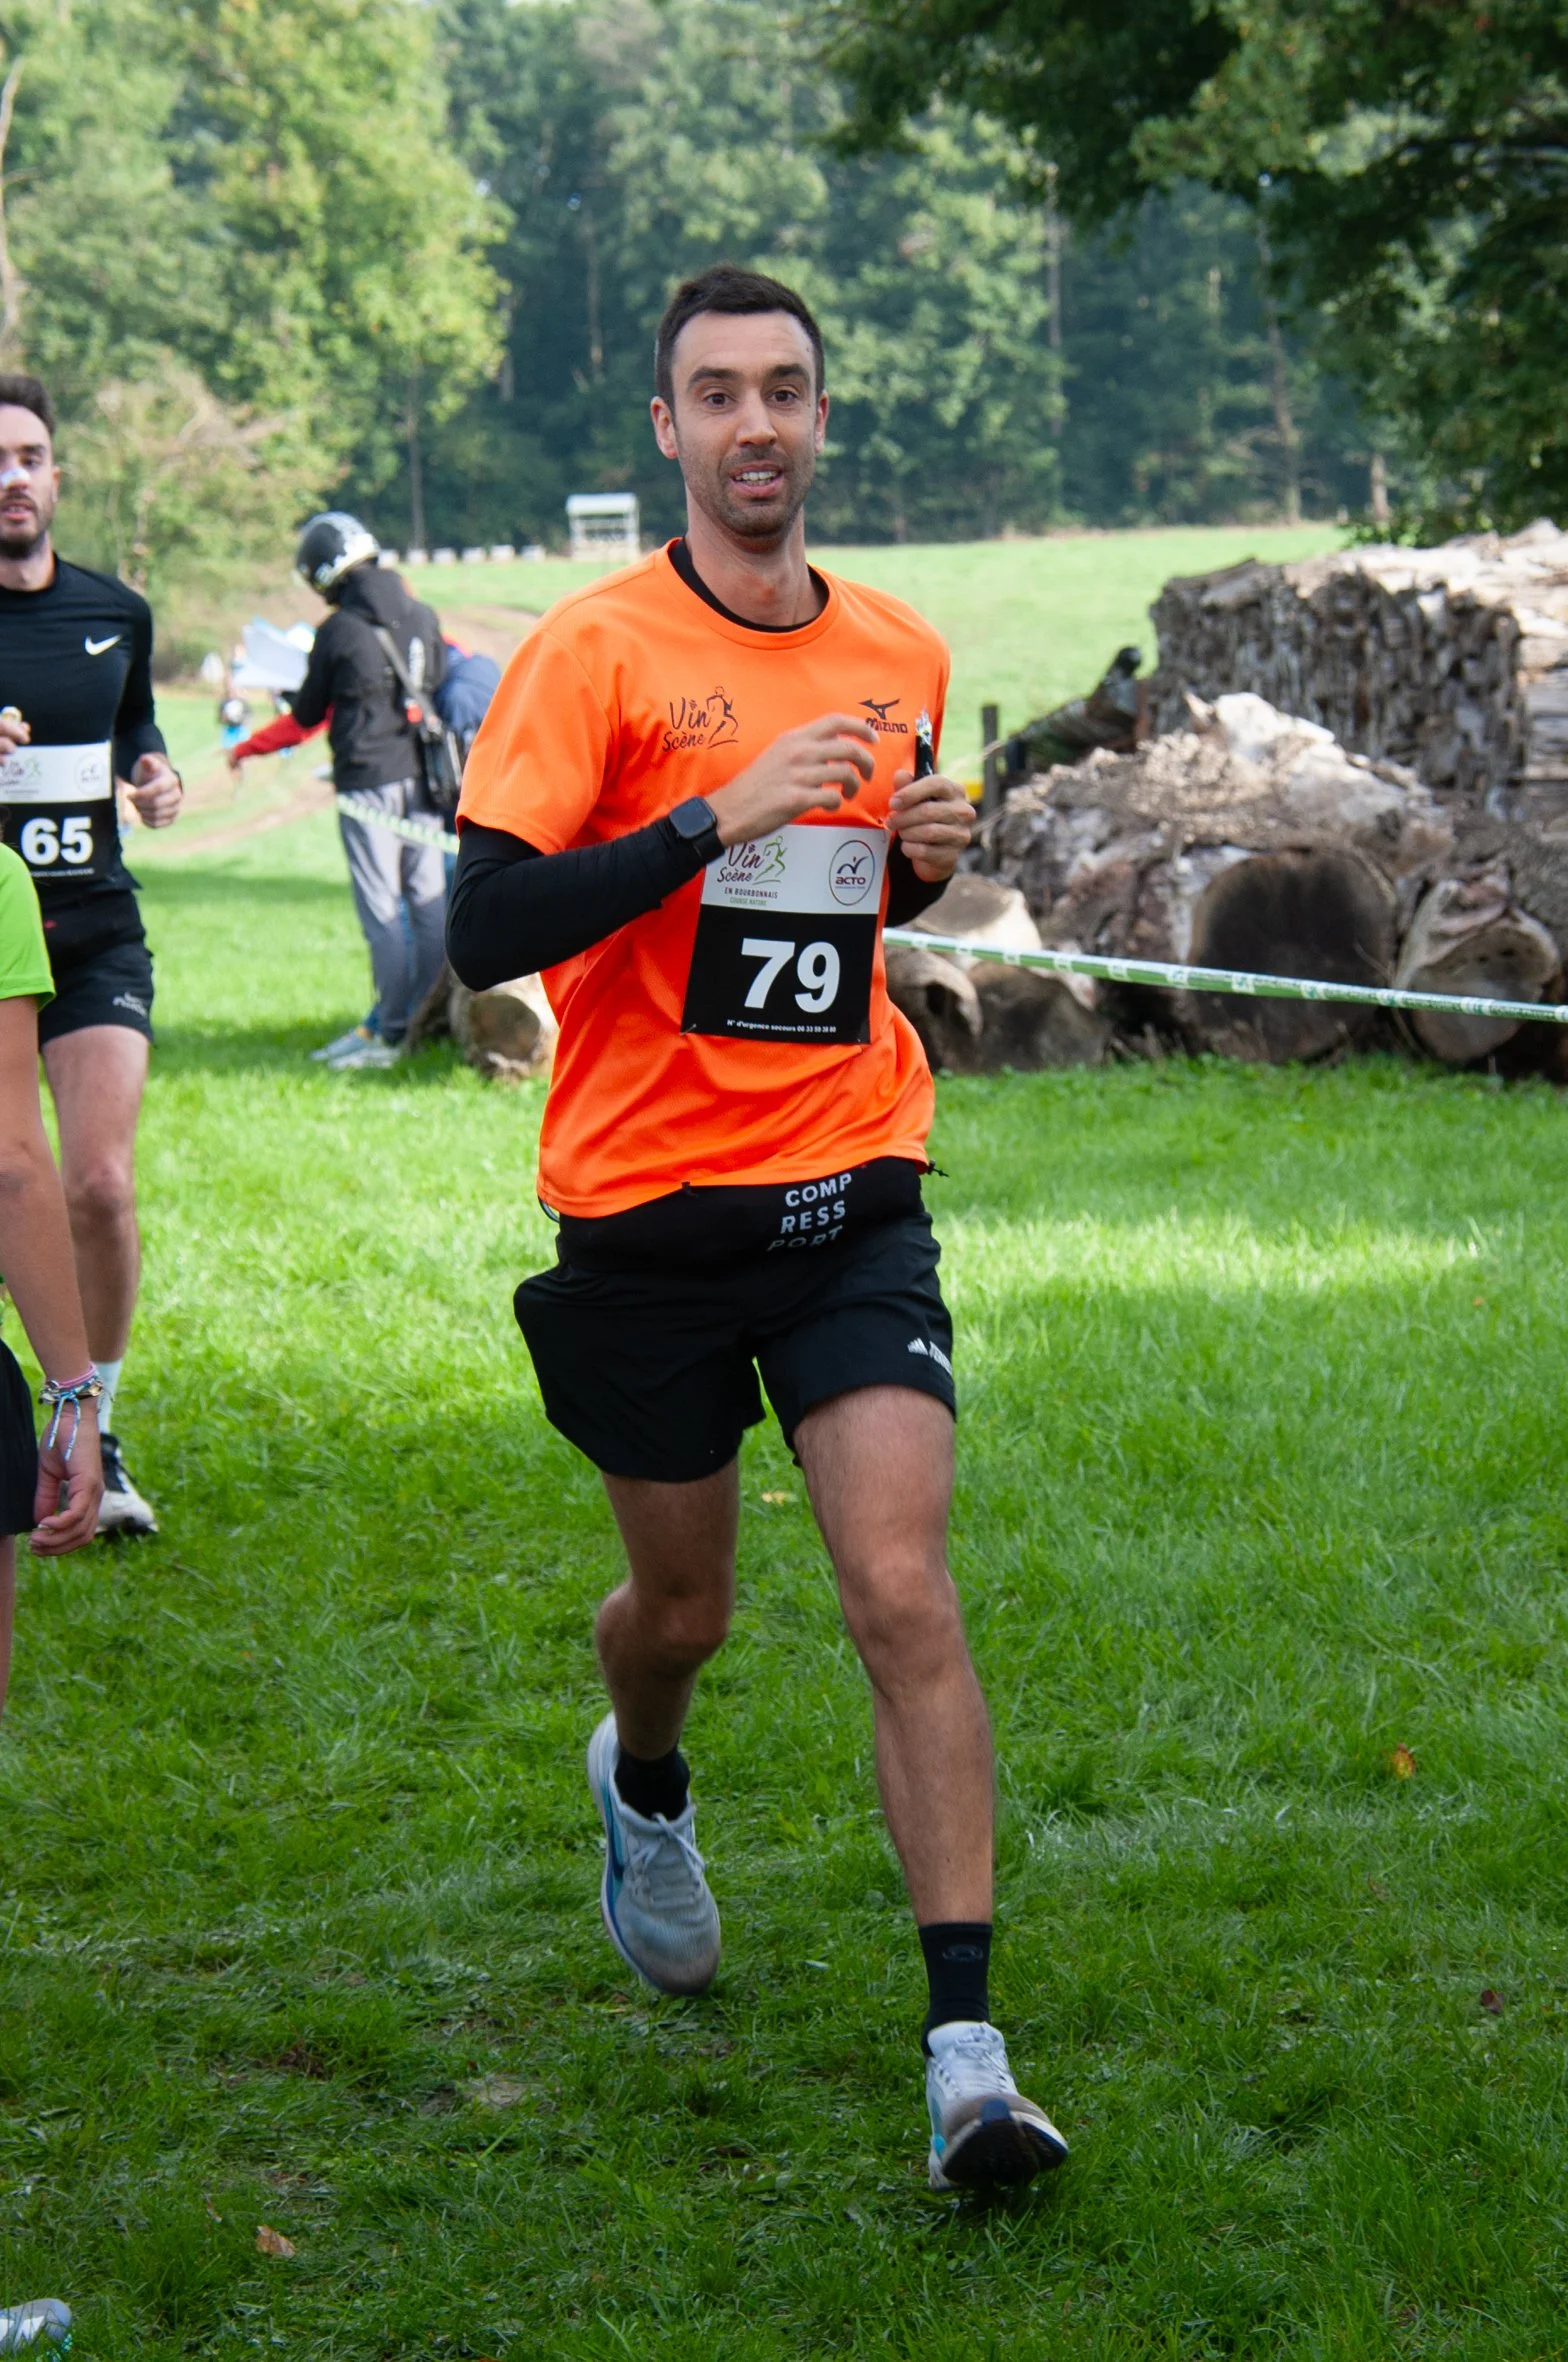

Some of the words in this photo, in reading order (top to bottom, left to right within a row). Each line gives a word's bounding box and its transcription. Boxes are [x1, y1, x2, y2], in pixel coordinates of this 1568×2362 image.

[669, 697, 711, 730] Vin
[662, 731, 705, 752] Scène
[21, 816, 93, 865] 65
[717, 866, 752, 883] Scène
[724, 886, 733, 895] EN
[734, 888, 778, 899] BOURBONNAIS
[741, 938, 840, 1013] 79
[785, 1173, 852, 1207] COMP
[780, 1200, 846, 1234] RESS
